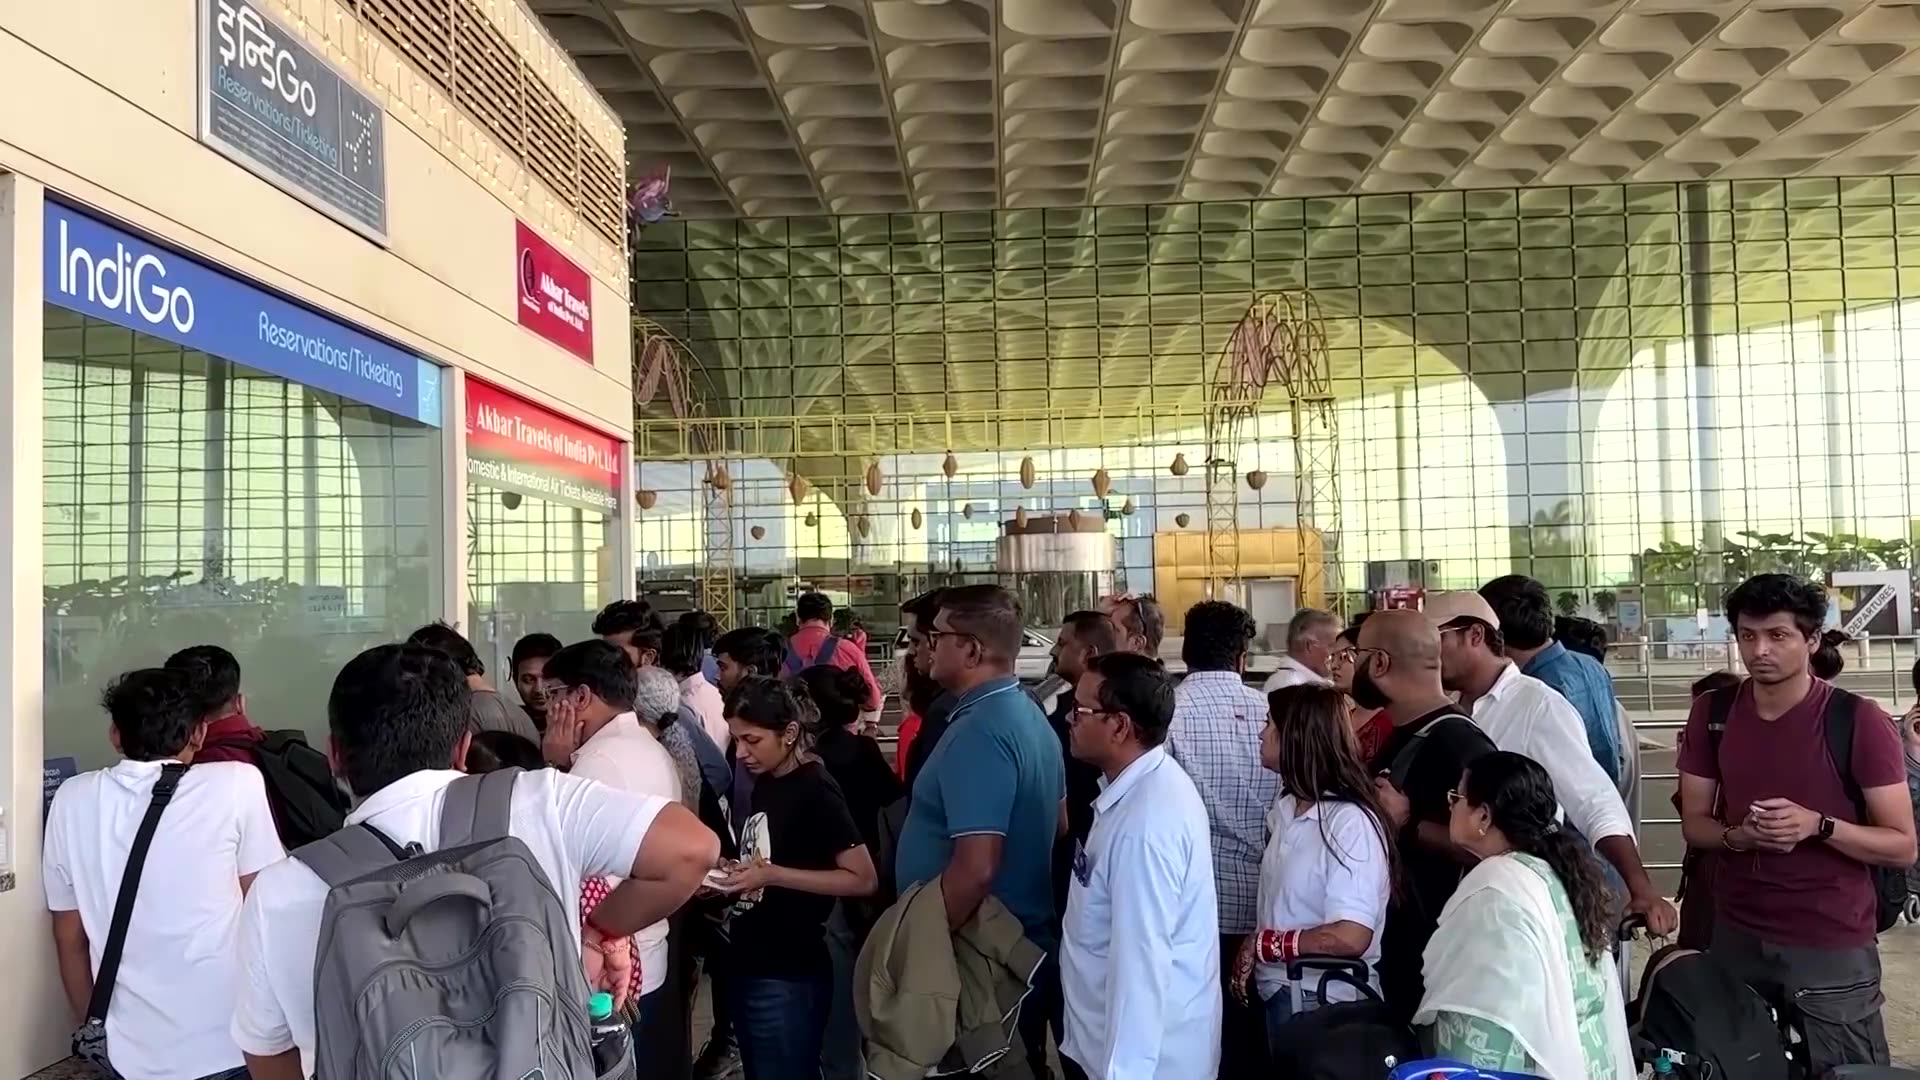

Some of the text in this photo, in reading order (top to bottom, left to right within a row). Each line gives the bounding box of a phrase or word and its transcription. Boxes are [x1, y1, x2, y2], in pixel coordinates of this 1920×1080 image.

[218, 65, 337, 167] Reservations/Ticketing
[59, 219, 195, 333] IndiGo
[258, 311, 403, 398] Reservations/Ticketing
[477, 402, 513, 438] Akbar
[514, 416, 552, 452] Travels
[553, 433, 564, 457] of
[564, 436, 587, 464] India
[466, 457, 500, 479] omestic
[500, 462, 508, 482] &
[507, 464, 550, 492] International
[550, 475, 560, 495] Air
[559, 479, 581, 498] Tickets
[1847, 584, 1896, 634] DEPARTURES
